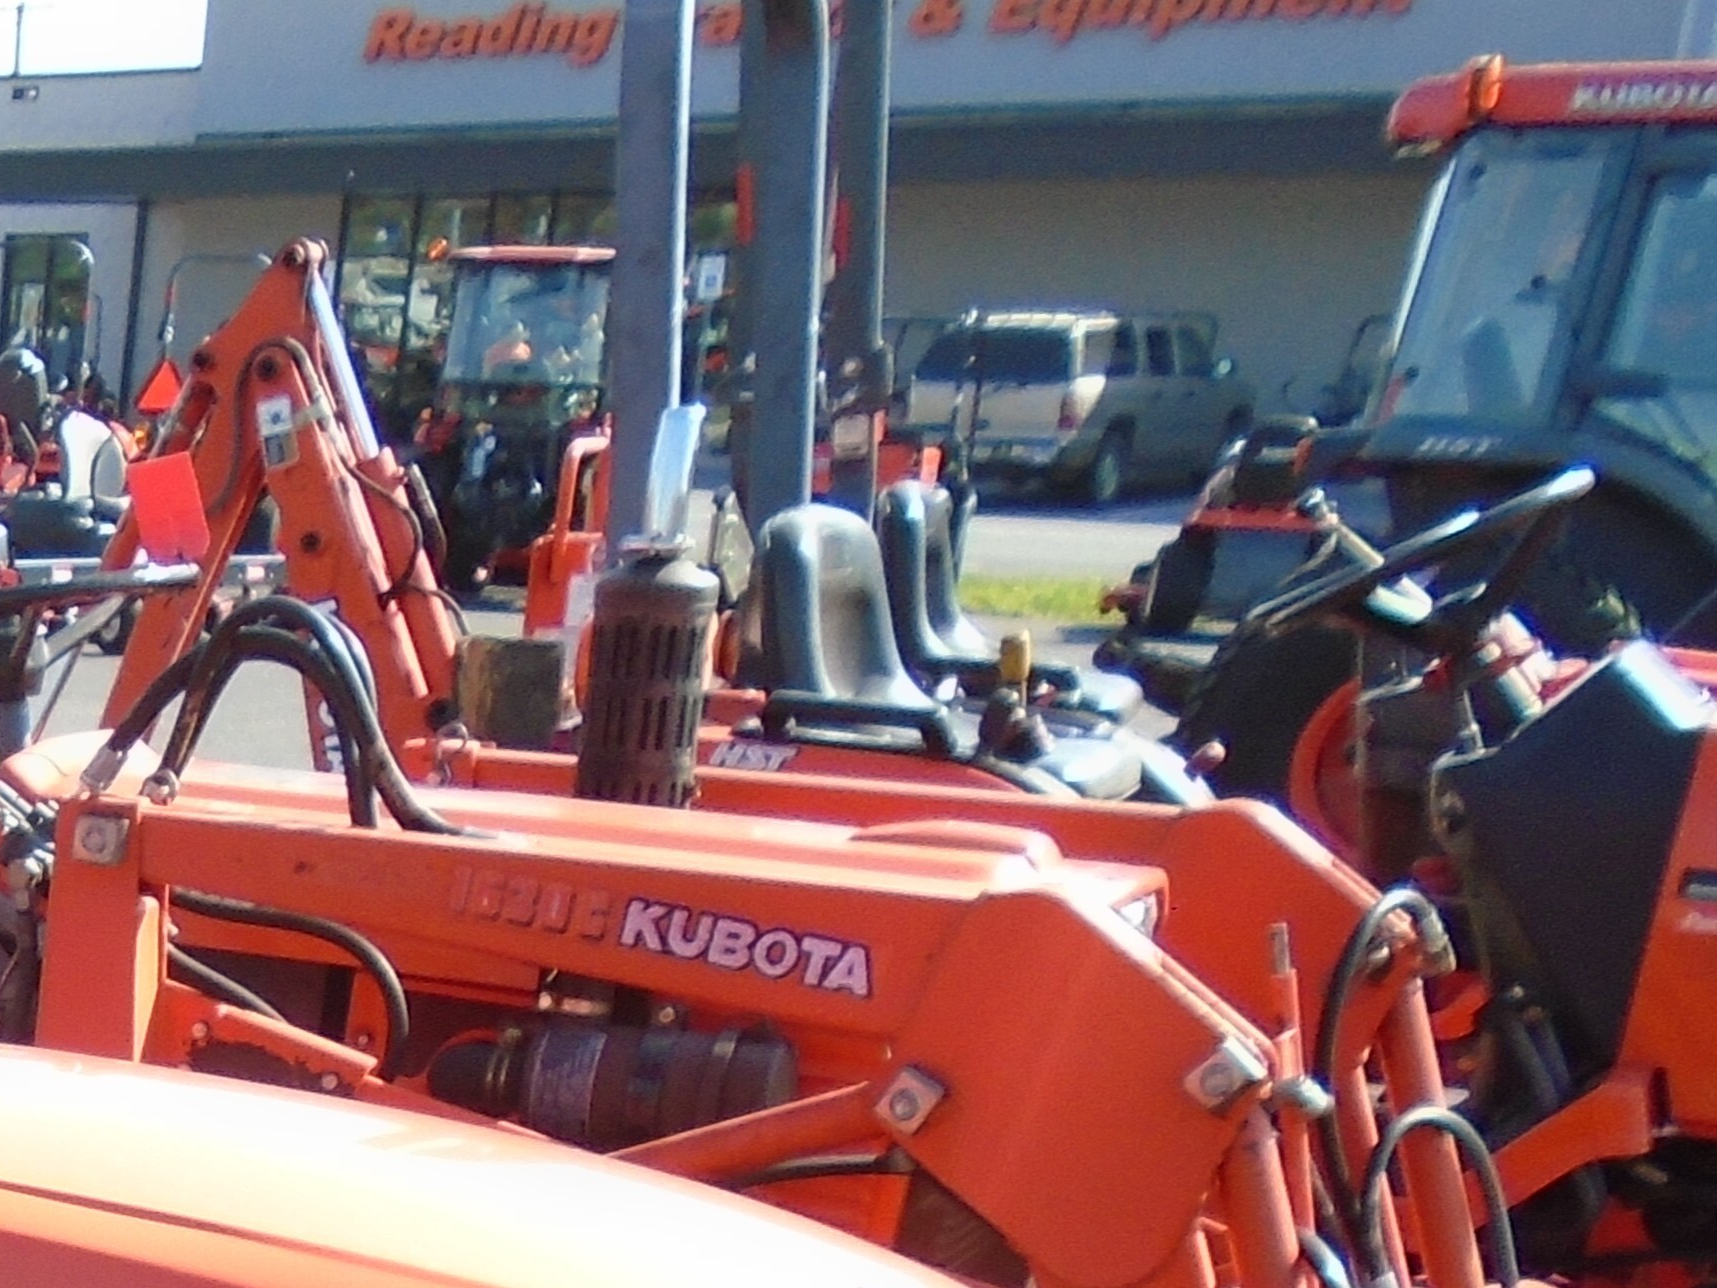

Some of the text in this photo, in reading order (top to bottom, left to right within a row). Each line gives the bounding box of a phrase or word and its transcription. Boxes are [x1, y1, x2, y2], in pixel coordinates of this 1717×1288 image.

[364, 3, 618, 68] Reading
[708, 740, 799, 772] HST
[619, 897, 872, 998] KUBOTA
